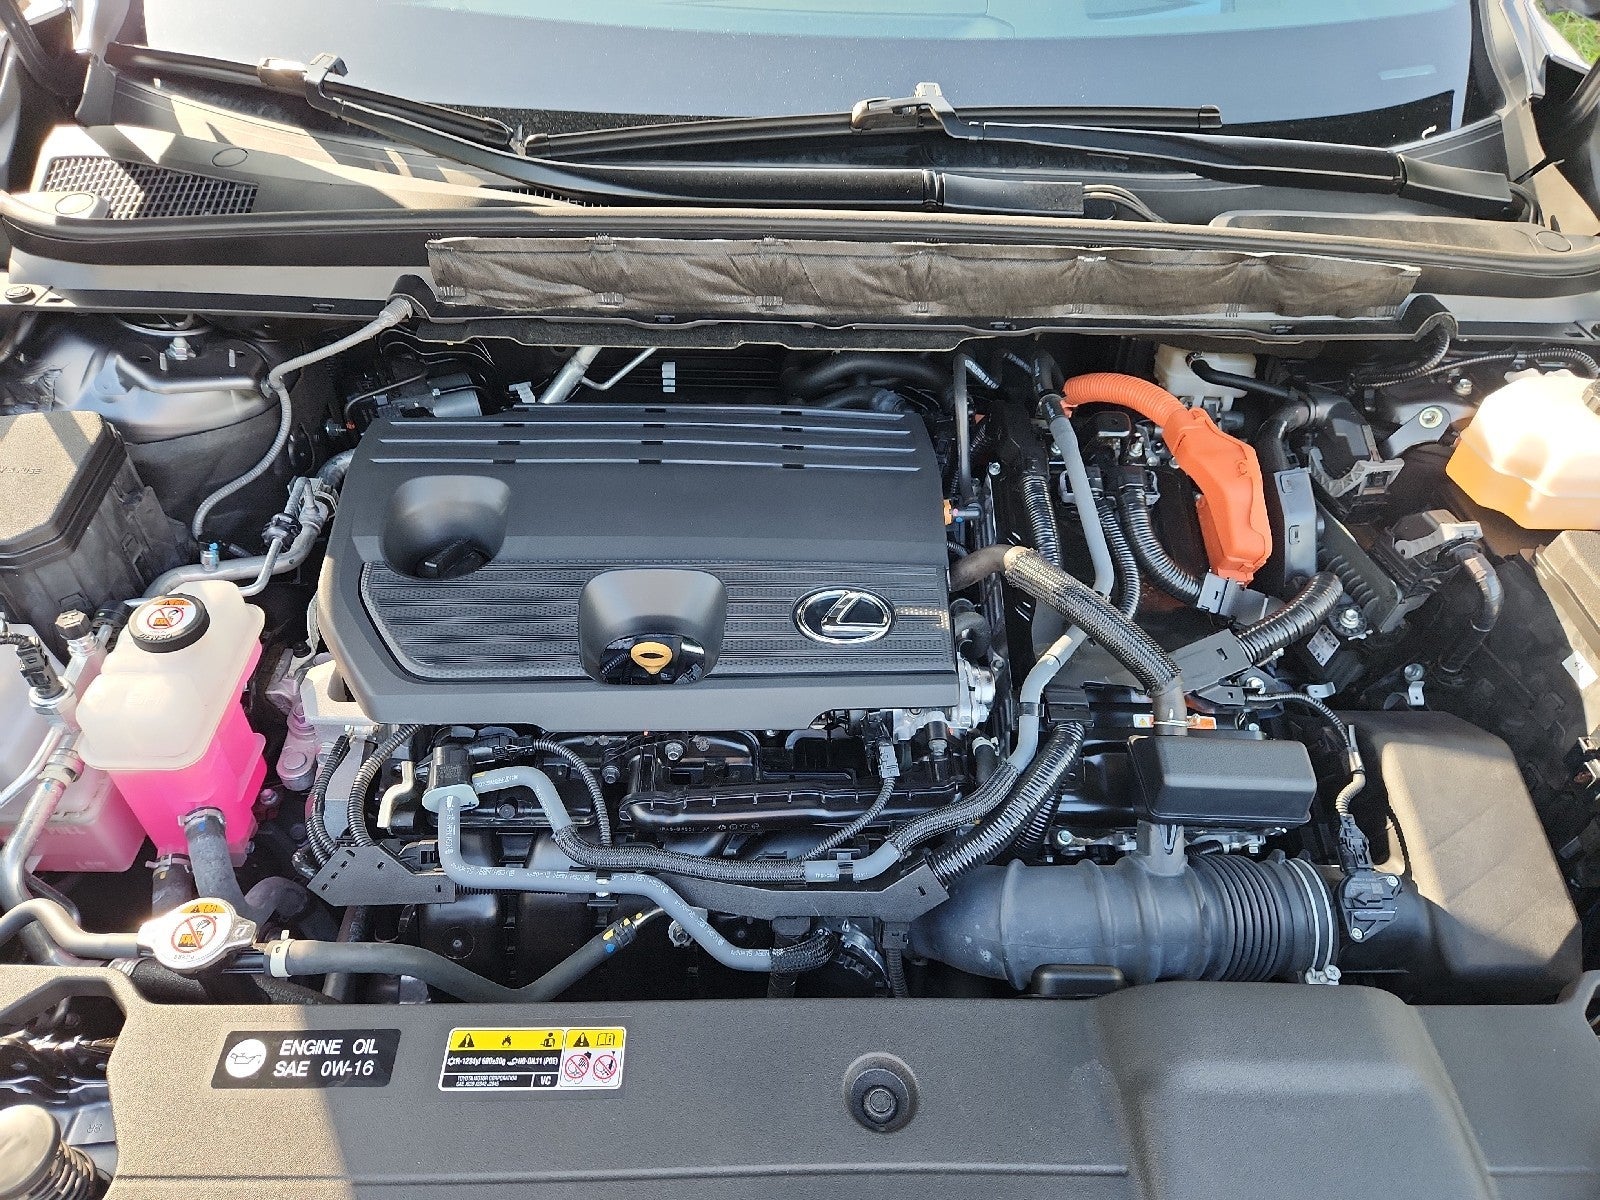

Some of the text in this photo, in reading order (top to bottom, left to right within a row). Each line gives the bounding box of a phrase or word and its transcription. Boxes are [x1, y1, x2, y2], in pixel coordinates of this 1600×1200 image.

[279, 1038, 379, 1056] ENGINE OIL
[273, 1060, 375, 1077] SAE 0W-16
[540, 1075, 552, 1085] VC
